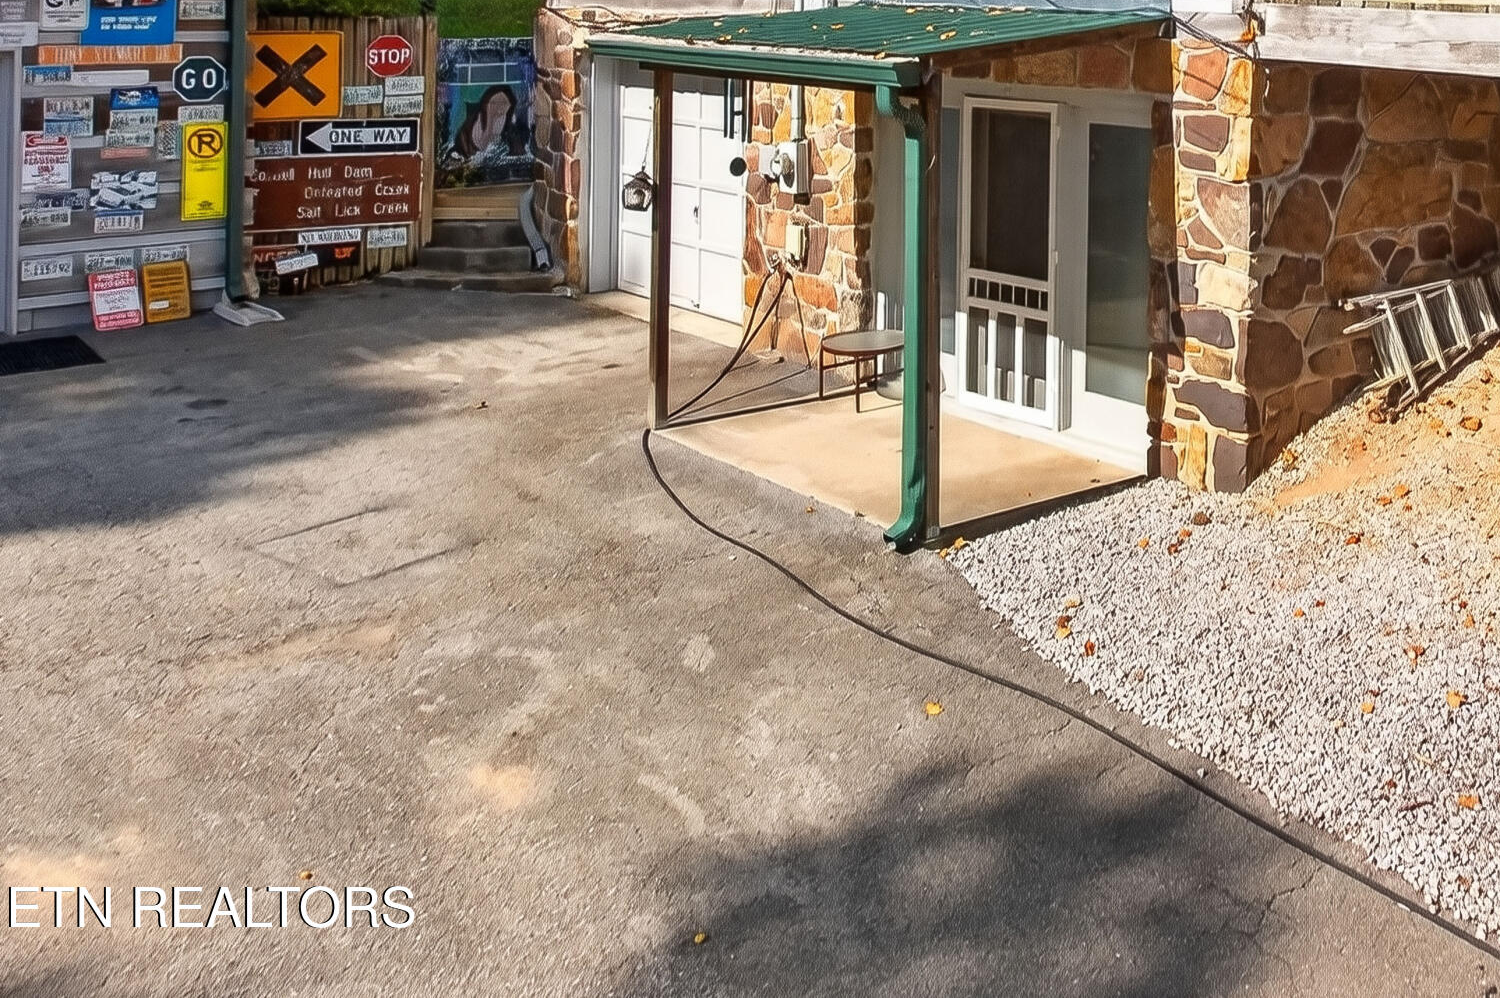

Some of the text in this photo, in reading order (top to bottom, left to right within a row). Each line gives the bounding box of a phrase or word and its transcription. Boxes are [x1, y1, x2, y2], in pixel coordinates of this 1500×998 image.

[369, 48, 411, 65] STOP
[181, 68, 217, 90] GO
[329, 129, 407, 143] ONE WAY
[344, 165, 373, 179] Dam
[335, 204, 361, 217] Lick
[373, 202, 409, 215] Creek
